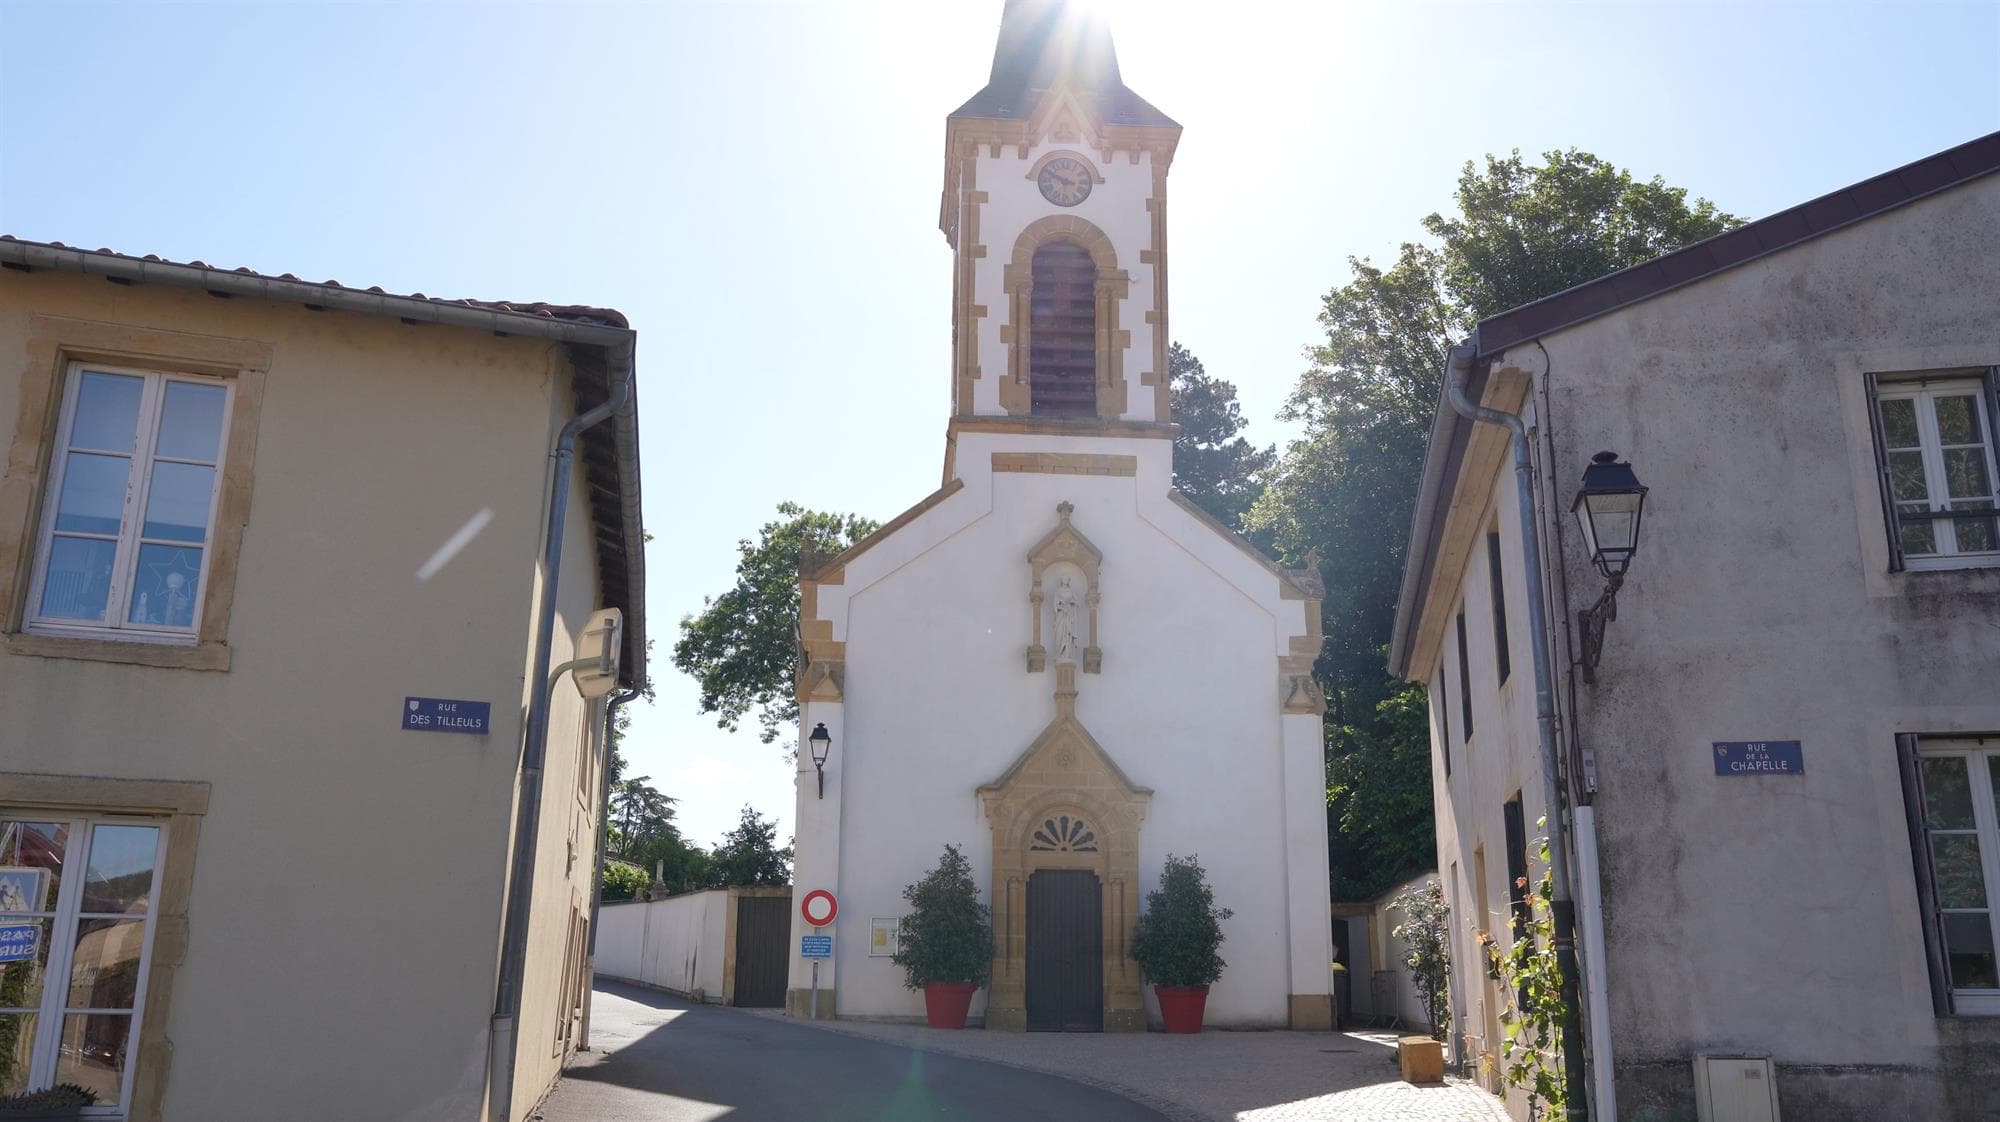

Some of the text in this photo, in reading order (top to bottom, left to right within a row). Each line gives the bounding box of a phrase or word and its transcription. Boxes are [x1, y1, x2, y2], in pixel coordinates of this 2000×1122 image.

[438, 703, 457, 712] RUE
[410, 714, 482, 728] DES TILLEULS
[1747, 743, 1767, 752] RUE
[1731, 760, 1788, 771] CHAPELLE
